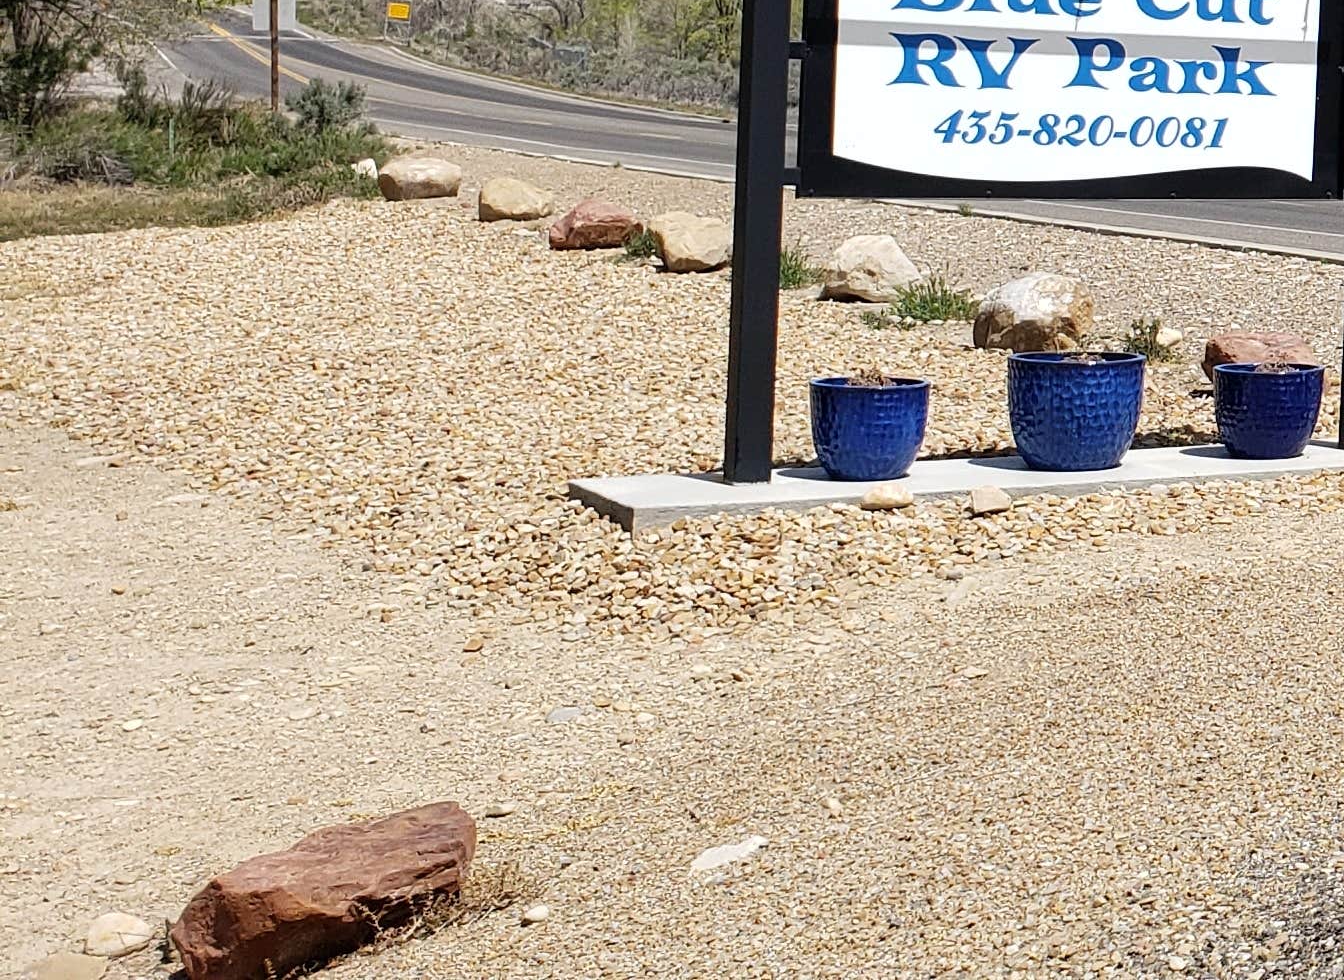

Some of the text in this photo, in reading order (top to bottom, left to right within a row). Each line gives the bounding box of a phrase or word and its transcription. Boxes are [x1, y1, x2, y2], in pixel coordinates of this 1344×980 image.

[888, 32, 1276, 97] RV Park
[932, 110, 1229, 150] 435-820-0081
